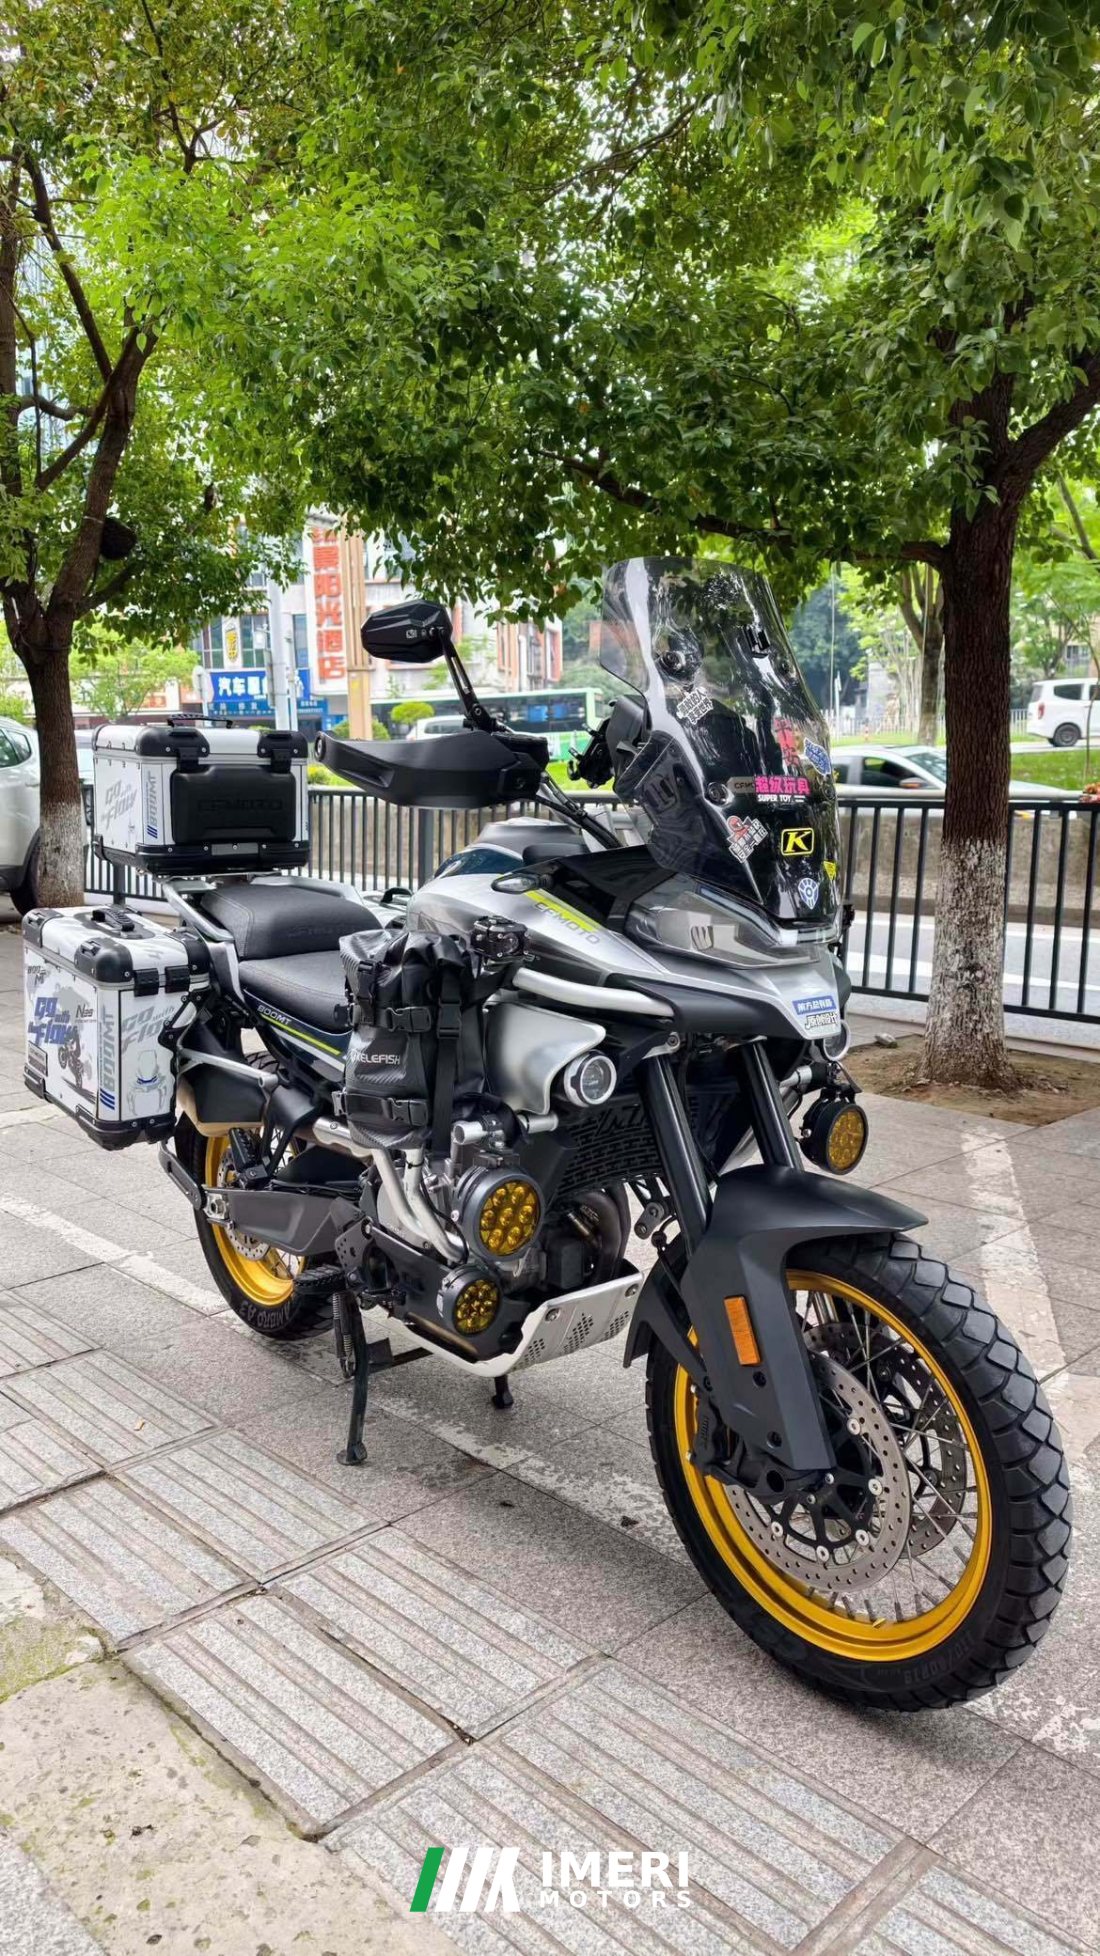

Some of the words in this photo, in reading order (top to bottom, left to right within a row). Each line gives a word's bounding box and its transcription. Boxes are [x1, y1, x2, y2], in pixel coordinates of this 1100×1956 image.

[755, 776, 811, 795] 超级玩具
[757, 794, 778, 802] SUPER
[784, 830, 812, 853] K
[535, 902, 600, 945] CFMOTO
[256, 1004, 292, 1026] 800MT
